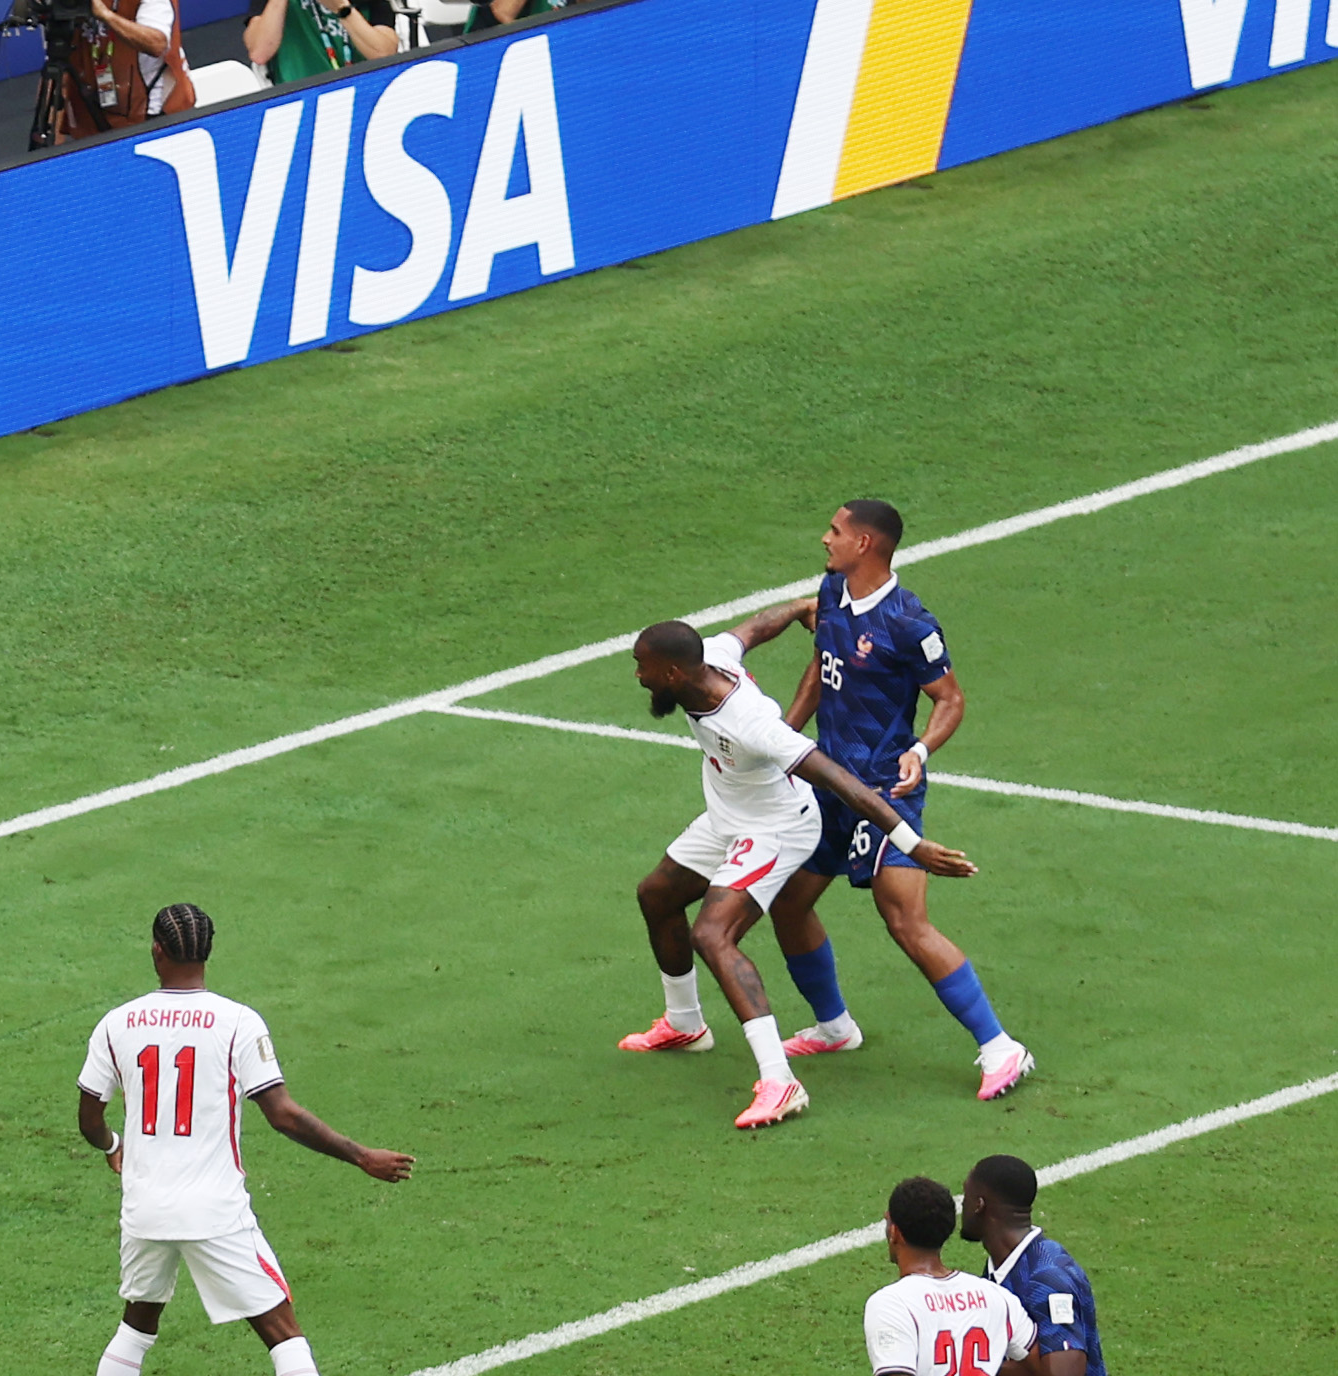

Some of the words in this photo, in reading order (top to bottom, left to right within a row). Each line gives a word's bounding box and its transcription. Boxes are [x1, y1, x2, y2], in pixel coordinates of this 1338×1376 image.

[134, 33, 576, 371] VISA
[820, 649, 845, 691] 26
[126, 1008, 216, 1029] RASHFORD
[137, 1044, 196, 1137] 11
